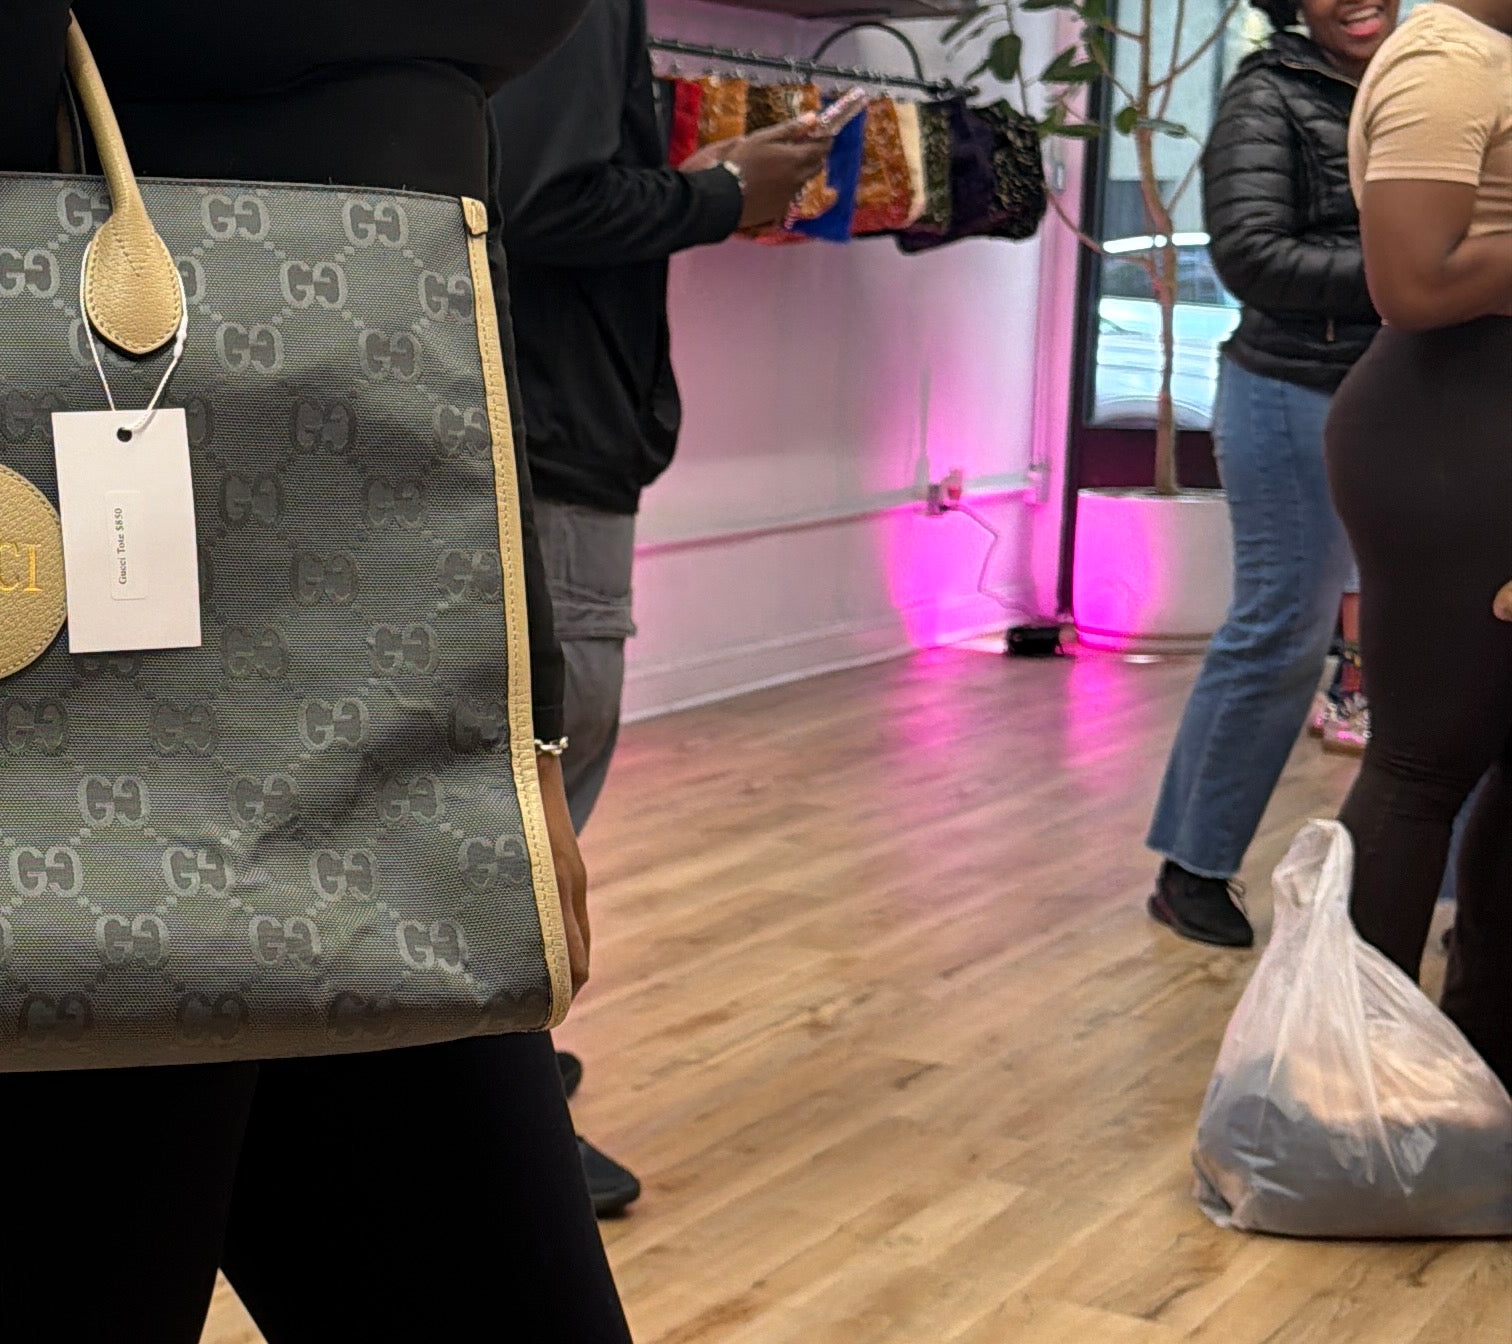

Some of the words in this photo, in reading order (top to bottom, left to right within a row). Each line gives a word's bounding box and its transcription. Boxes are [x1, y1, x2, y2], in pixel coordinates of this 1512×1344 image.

[114, 507, 124, 531] $850
[116, 533, 126, 554] Tote
[117, 557, 127, 585] Gucci
